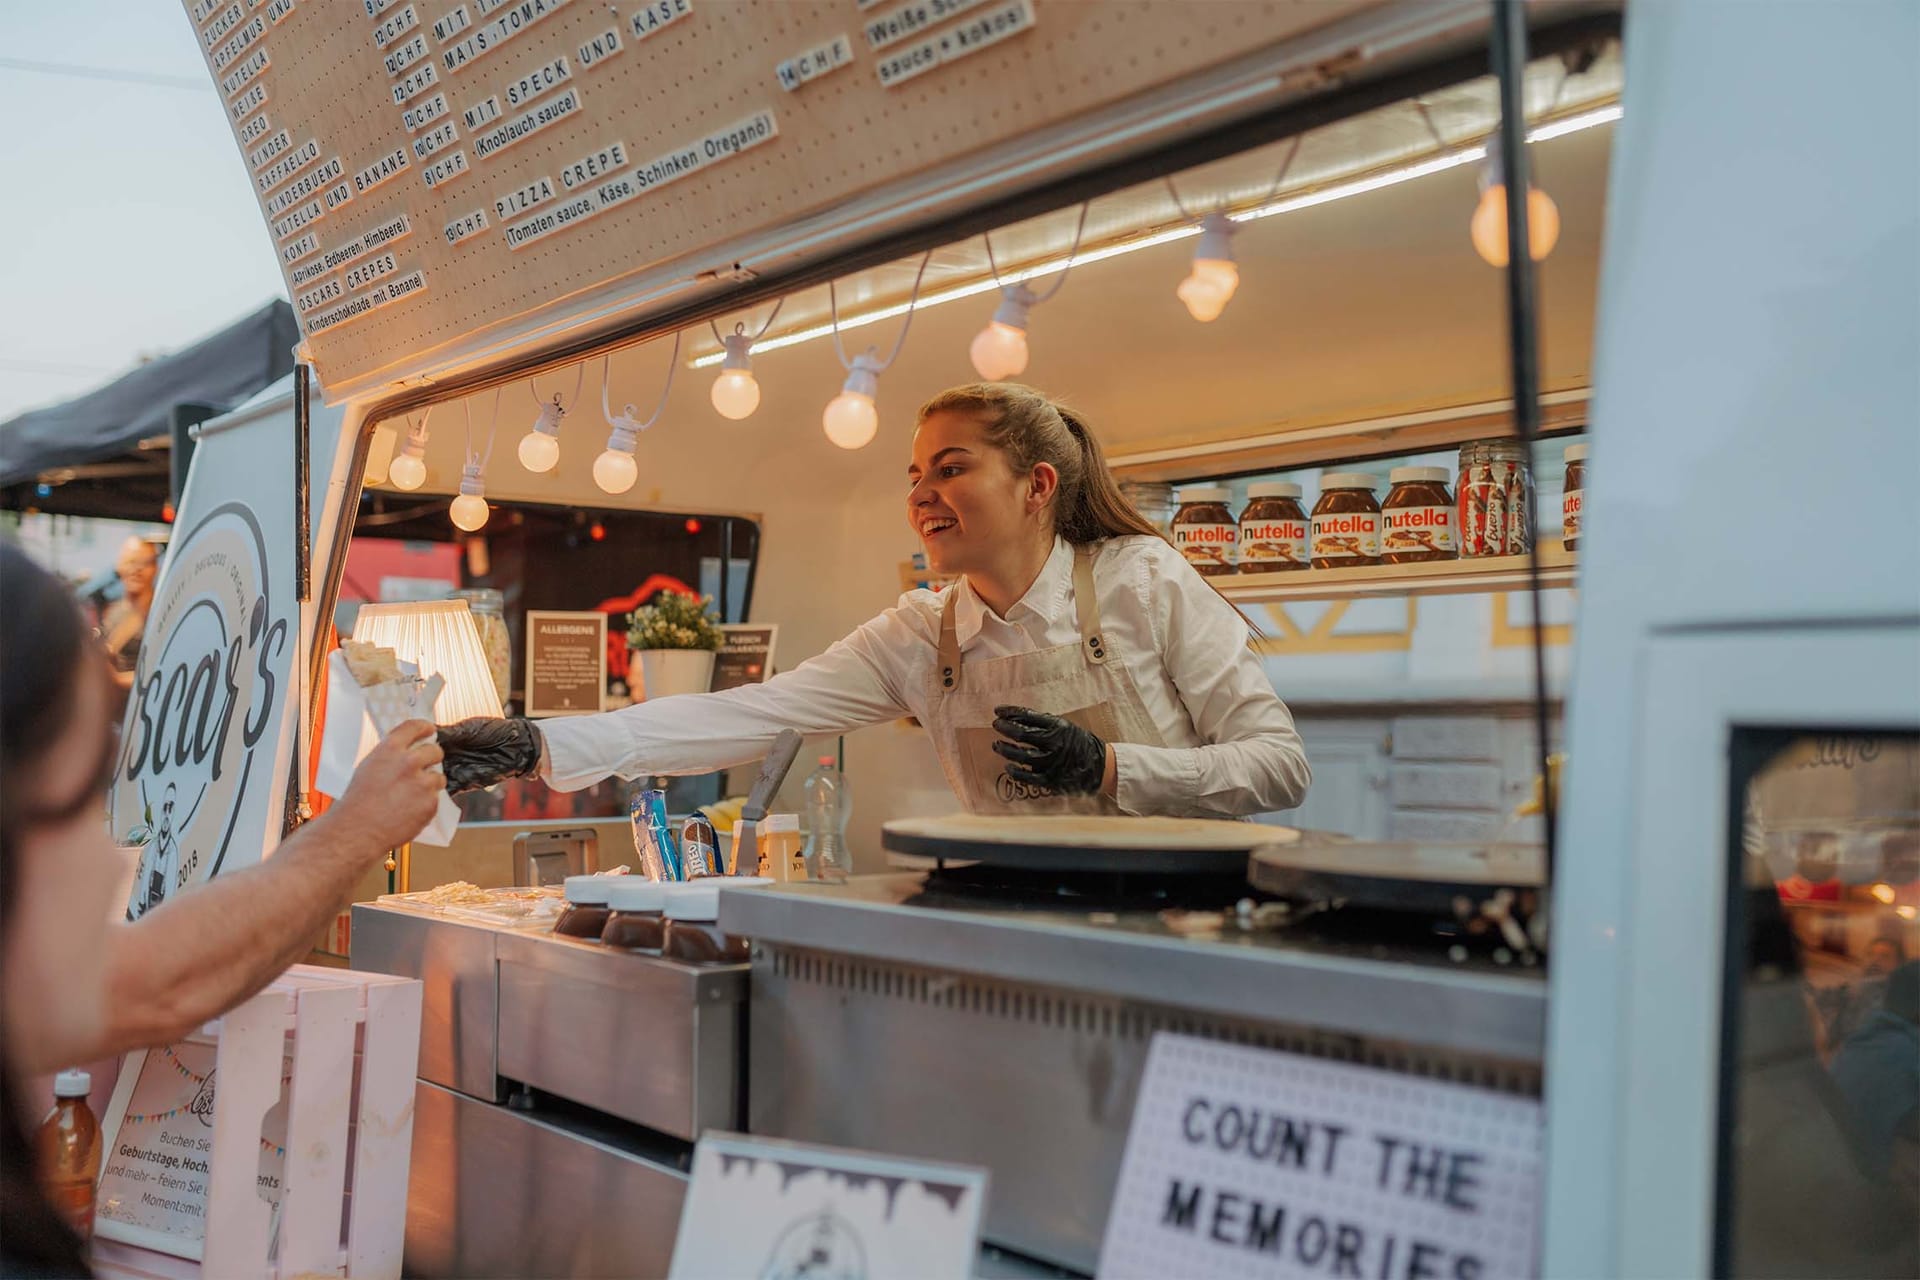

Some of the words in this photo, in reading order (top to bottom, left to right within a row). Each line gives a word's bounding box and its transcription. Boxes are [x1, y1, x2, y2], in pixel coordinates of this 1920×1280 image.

[195, 0, 218, 22] ZIM
[205, 5, 241, 45] ZUCKER
[434, 9, 465, 40] MIT
[214, 18, 263, 70] APFELMUS
[268, 0, 291, 21] UND
[223, 51, 267, 94] NUTELLA
[464, 99, 497, 128] MIT
[509, 59, 567, 104] SPECK
[580, 32, 617, 64] UND
[241, 116, 266, 143] OREO
[476, 114, 537, 157] (Knoblauch
[538, 91, 577, 124] sauce)
[251, 133, 289, 168] KINDER
[258, 142, 317, 191] RAFFAELLO
[268, 160, 340, 216] KINDERBUENO
[275, 202, 321, 238] NUTELLA
[326, 185, 348, 208] UND
[355, 150, 406, 191] BANANE
[496, 181, 551, 218] PIZZA
[506, 215, 555, 245] (Tomaten
[557, 199, 596, 222] sauce,
[598, 182, 635, 205] Käse,
[637, 151, 699, 187] Schinken
[283, 235, 315, 263] KONFI
[325, 243, 364, 268] Erdbeeren,
[363, 217, 406, 249] Himbeere)
[299, 281, 341, 311] OSCARS
[307, 297, 371, 333] (Kinderschokolade
[373, 290, 388, 305] mit
[388, 273, 423, 298] Banane)
[1177, 526, 1236, 543] nutella
[1244, 522, 1305, 540] nutella
[1313, 516, 1375, 535] nutella
[1384, 508, 1449, 529] nutella
[1486, 502, 1499, 541] bueno
[178, 849, 198, 889] 2018
[119, 1144, 181, 1170] Geburtstage,
[160, 1131, 197, 1148] Buchen
[197, 1138, 212, 1152] Sie
[1182, 1097, 1348, 1176] COUNT
[1374, 1132, 1487, 1213] THE
[107, 1164, 125, 1177] und
[125, 1168, 150, 1182] mehr
[158, 1173, 186, 1192] Feiern
[187, 1181, 203, 1194] Sie
